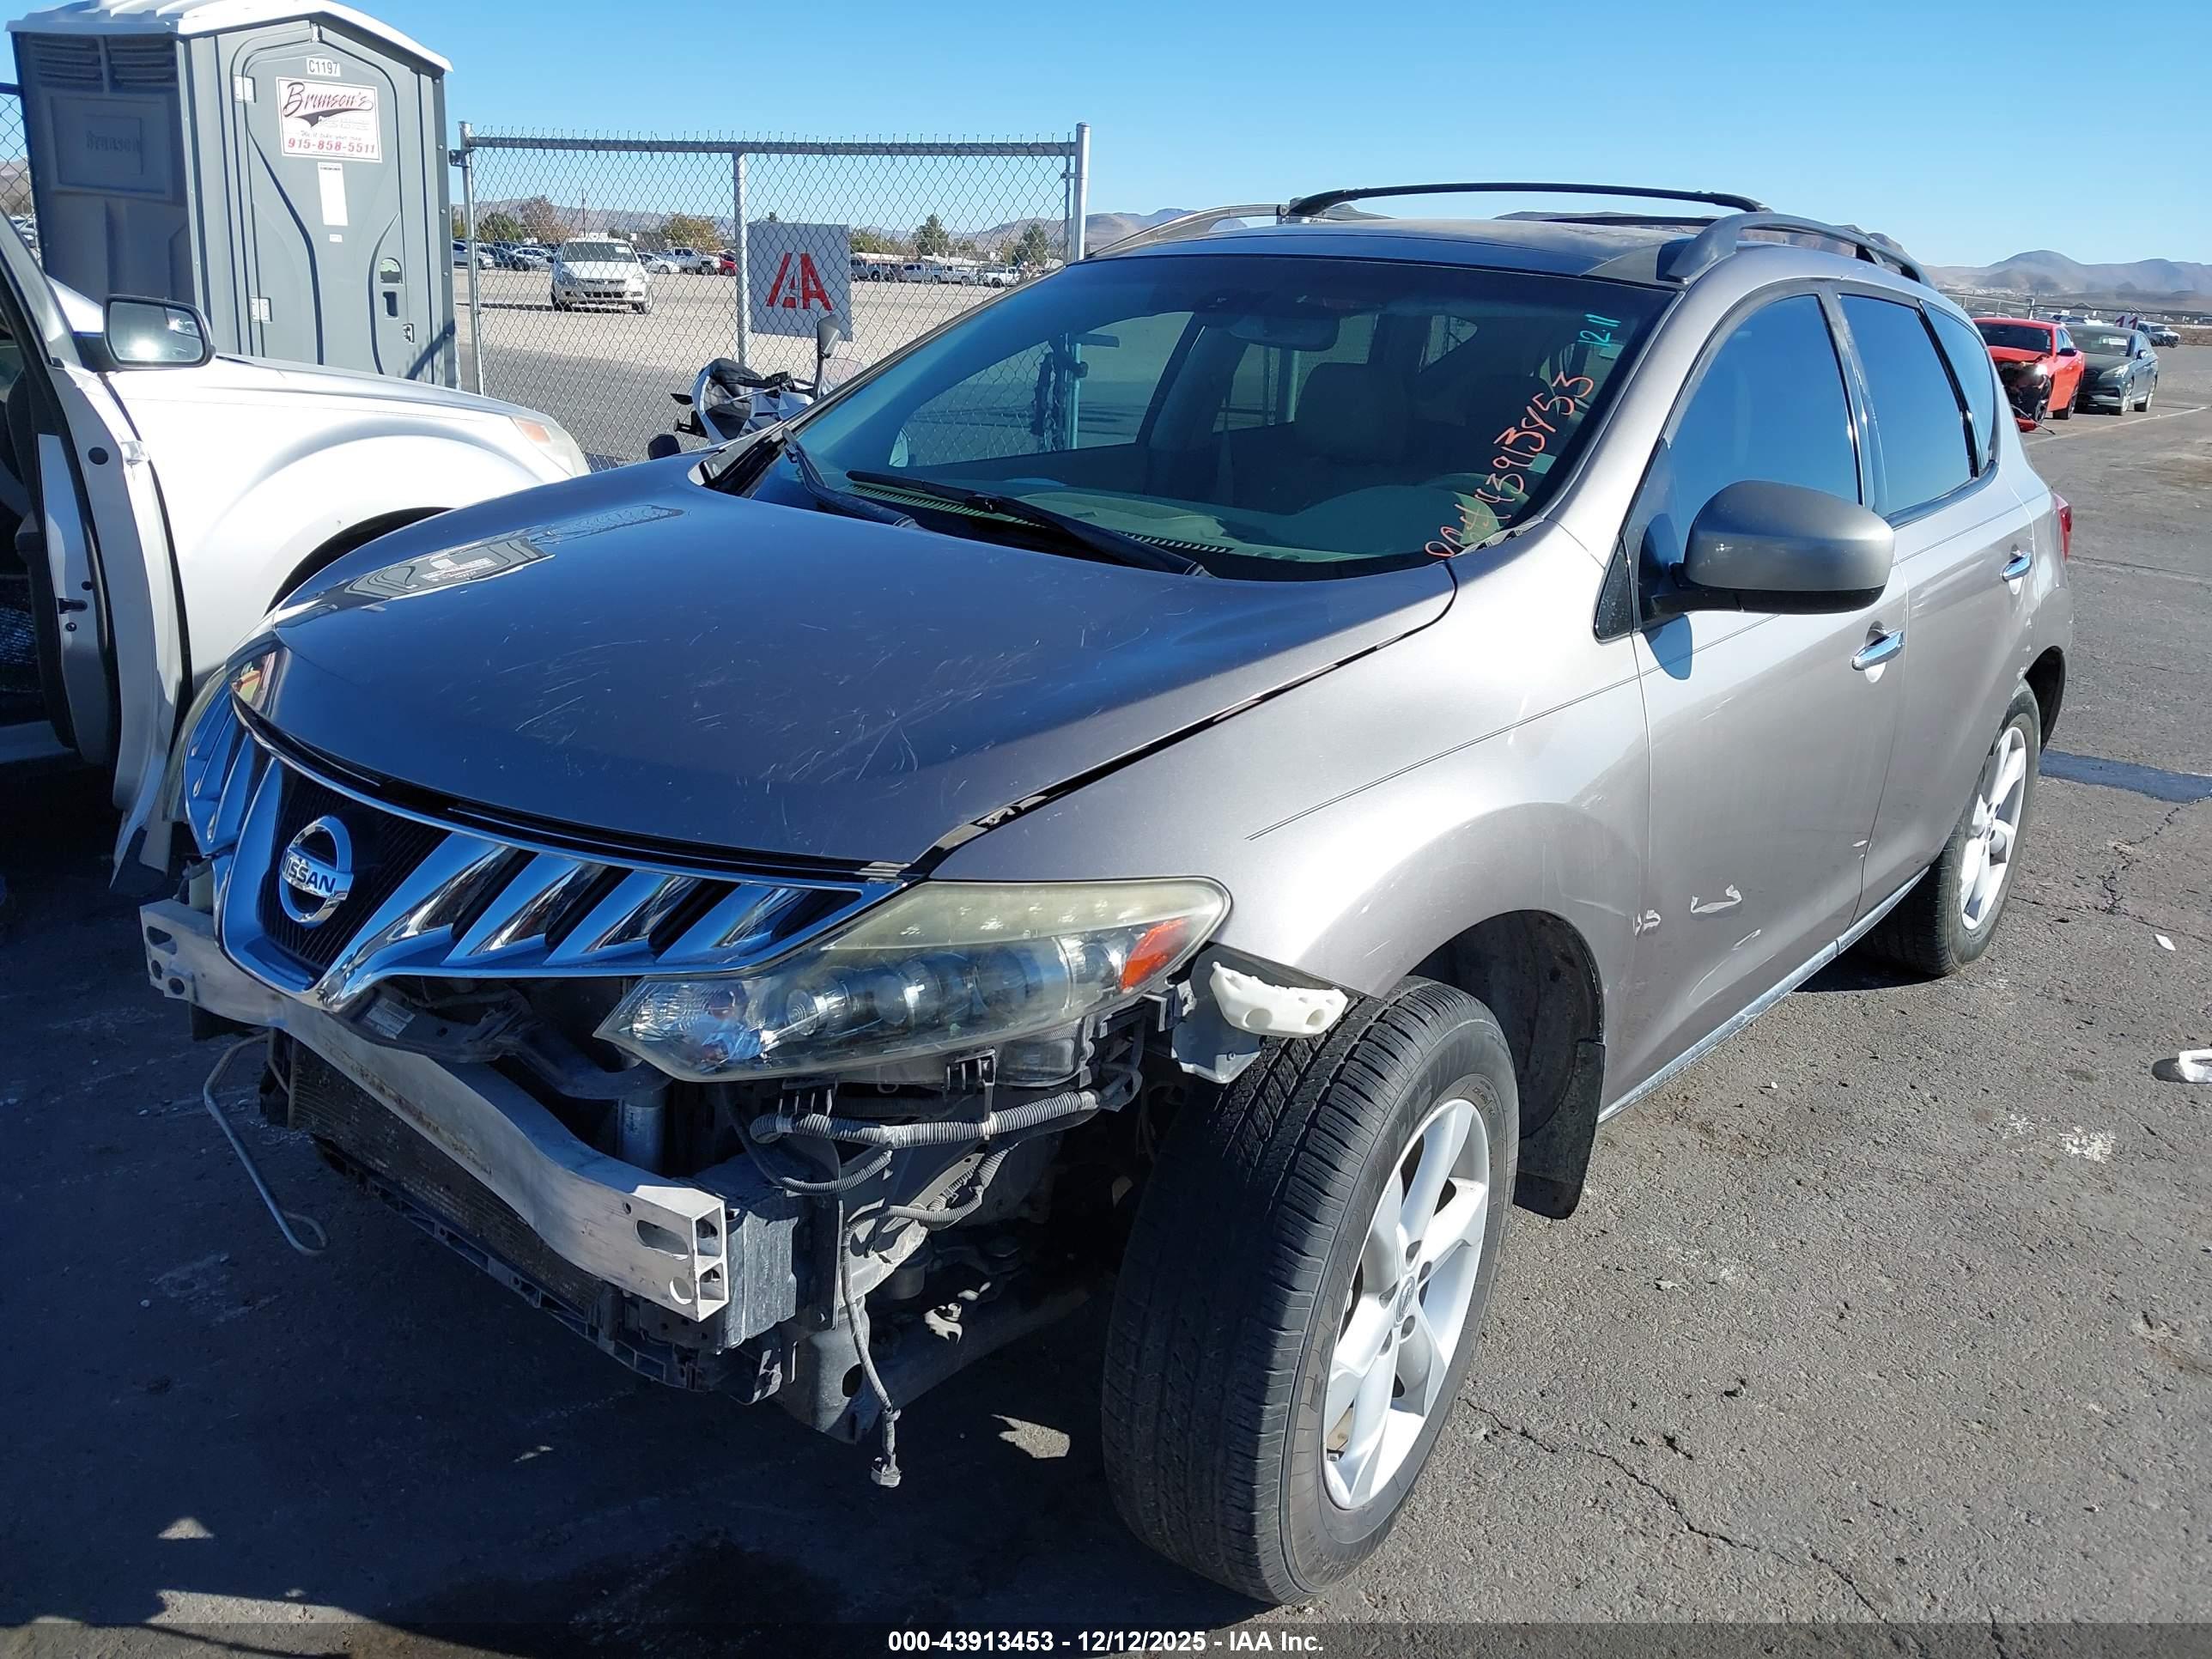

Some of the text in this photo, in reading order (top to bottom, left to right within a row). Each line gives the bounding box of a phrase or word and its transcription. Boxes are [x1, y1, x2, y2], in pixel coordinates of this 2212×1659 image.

[309, 59, 338, 75] C1197
[288, 137, 375, 154] 915-858-5511
[283, 858, 336, 893] NISSAN
